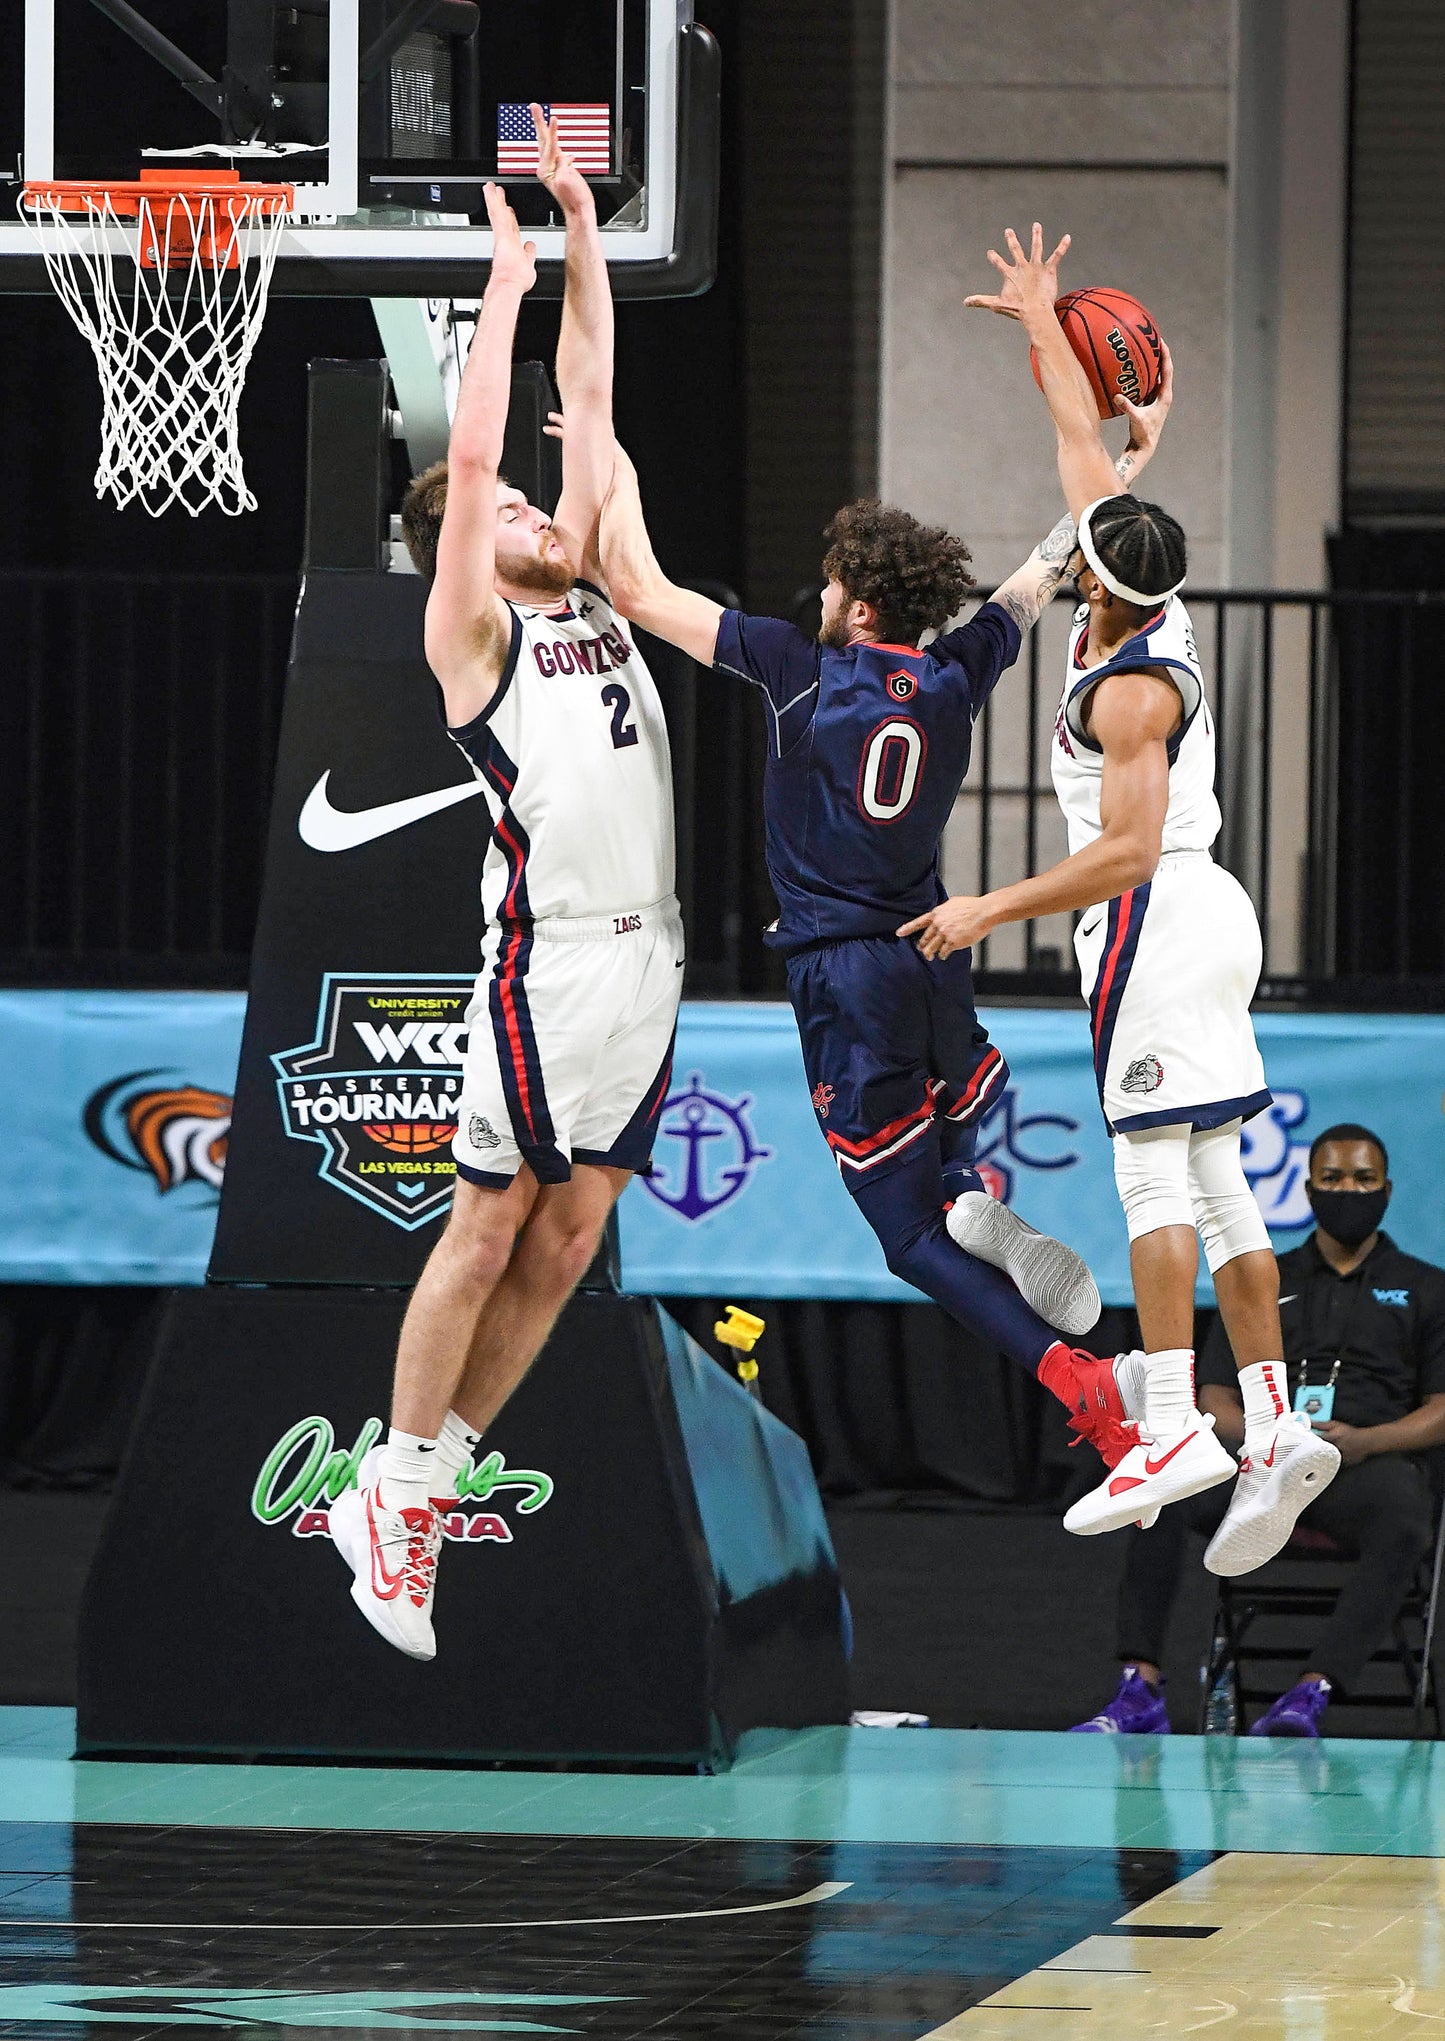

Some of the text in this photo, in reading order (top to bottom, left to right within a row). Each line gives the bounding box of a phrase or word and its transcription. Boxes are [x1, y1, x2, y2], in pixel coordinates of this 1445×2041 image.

[895, 679, 908, 695] G
[601, 683, 639, 749] 2
[857, 717, 927, 824] 0
[613, 915, 642, 935] ZAGS
[368, 997, 461, 1009] UNIVERSITY
[388, 1010, 443, 1018] credit union
[352, 1022, 469, 1064] WCC
[359, 1161, 386, 1174] LAS
[387, 1161, 432, 1174] VEGAS
